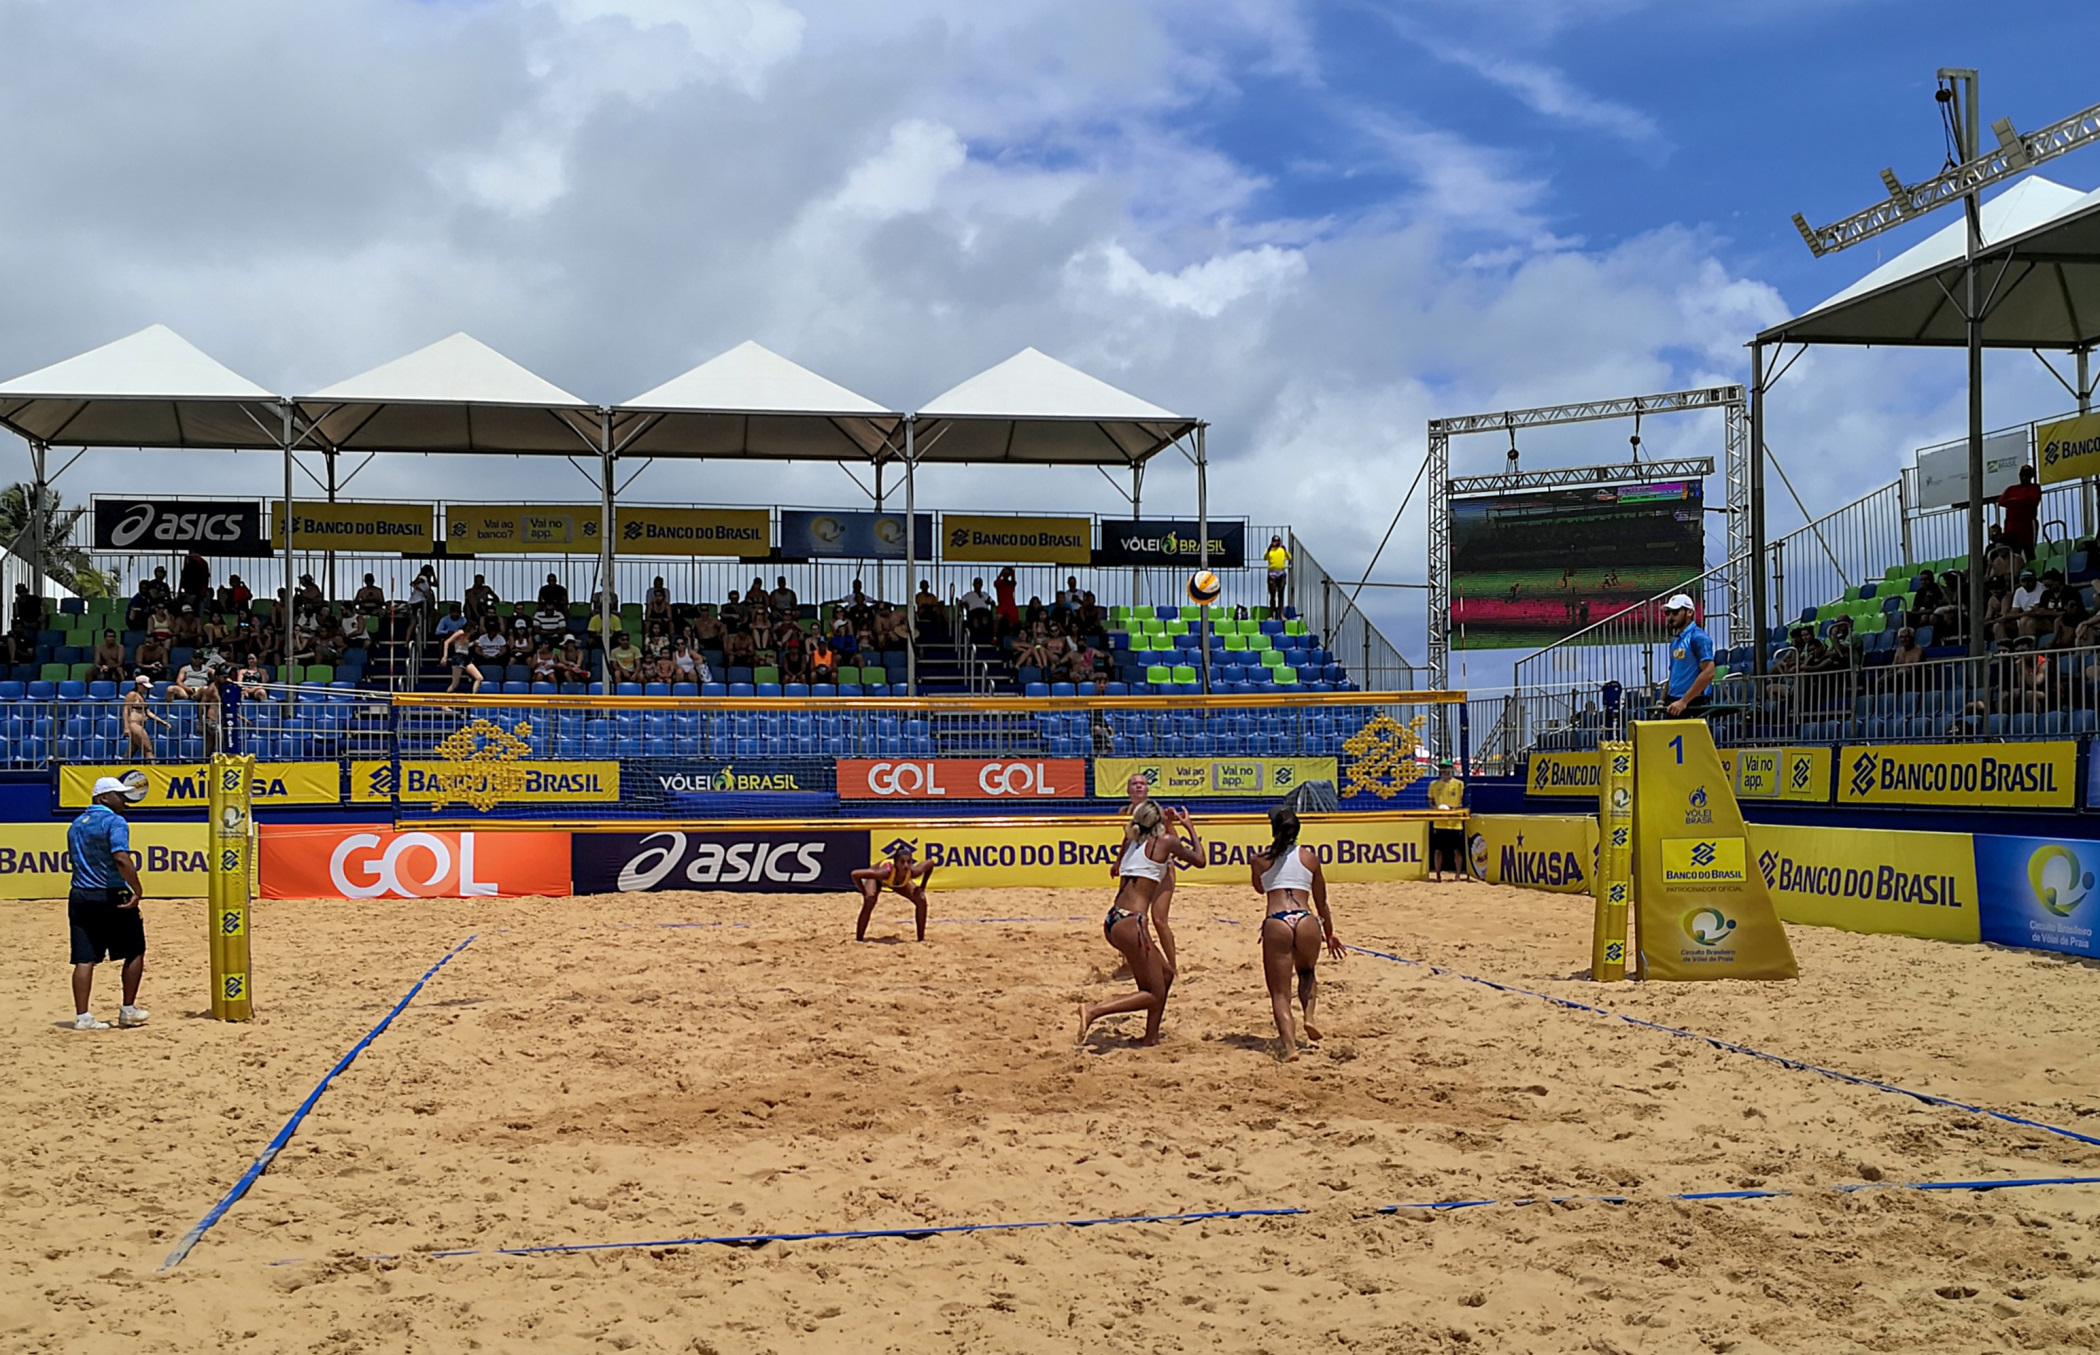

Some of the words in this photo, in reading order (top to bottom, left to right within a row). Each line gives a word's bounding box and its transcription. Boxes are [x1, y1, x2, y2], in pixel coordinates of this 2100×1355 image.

[2062, 437, 2100, 459] BANCO
[304, 519, 354, 535] BANCO
[355, 522, 373, 535] DO
[376, 520, 425, 536] BRASIL
[484, 519, 499, 529] Vai
[501, 521, 514, 529] ao
[530, 518, 546, 529] Vai
[548, 521, 562, 529] no
[477, 529, 514, 539] banco?
[531, 530, 552, 539] app.
[646, 524, 693, 539] BANCO
[695, 527, 713, 540] DO
[716, 525, 762, 541] BRASIL
[972, 531, 1018, 546] BANCO
[1020, 534, 1036, 547] DO
[1038, 532, 1083, 548] BRASIL
[1121, 536, 1160, 551] VÔLEI
[1668, 735, 1683, 764] 1
[1176, 766, 1192, 776] Vai
[1222, 765, 1238, 776] Vai
[1240, 768, 1253, 776] no
[1745, 755, 1759, 771] Vai
[1760, 759, 1773, 771] no
[526, 770, 603, 793] BRASIL
[659, 773, 711, 791] VÔLEI
[738, 774, 798, 791] BRASIL
[867, 763, 945, 795] GOL
[979, 763, 1055, 795] GOL
[1169, 777, 1205, 787] banco?
[1222, 777, 1244, 787] app.
[1551, 762, 1588, 786] BANCO
[1744, 775, 1763, 790] app.
[1880, 758, 1946, 792] BANCO
[1950, 763, 1977, 792] DO
[1980, 757, 2058, 792] BRASIL
[1684, 808, 1712, 817] VÔLEI
[0, 848, 72, 874] BANC
[148, 846, 209, 872] BRA
[925, 842, 1016, 867] BANCO
[1020, 843, 1054, 866] DO
[1059, 840, 1123, 865] BRAS
[1209, 841, 1271, 866] BAN
[1337, 839, 1422, 863] BRASIL
[329, 832, 498, 898] GOL
[1666, 870, 1697, 880] BANCO
[1698, 870, 1710, 879] DO
[1711, 869, 1743, 879] BRASIL
[1779, 857, 1840, 897] BANCO
[1843, 869, 1871, 899] DO
[1875, 865, 1962, 908] BRASIL
[2031, 932, 2040, 942] de
[2060, 936, 2069, 946] de
[2069, 937, 2089, 948] Praia
